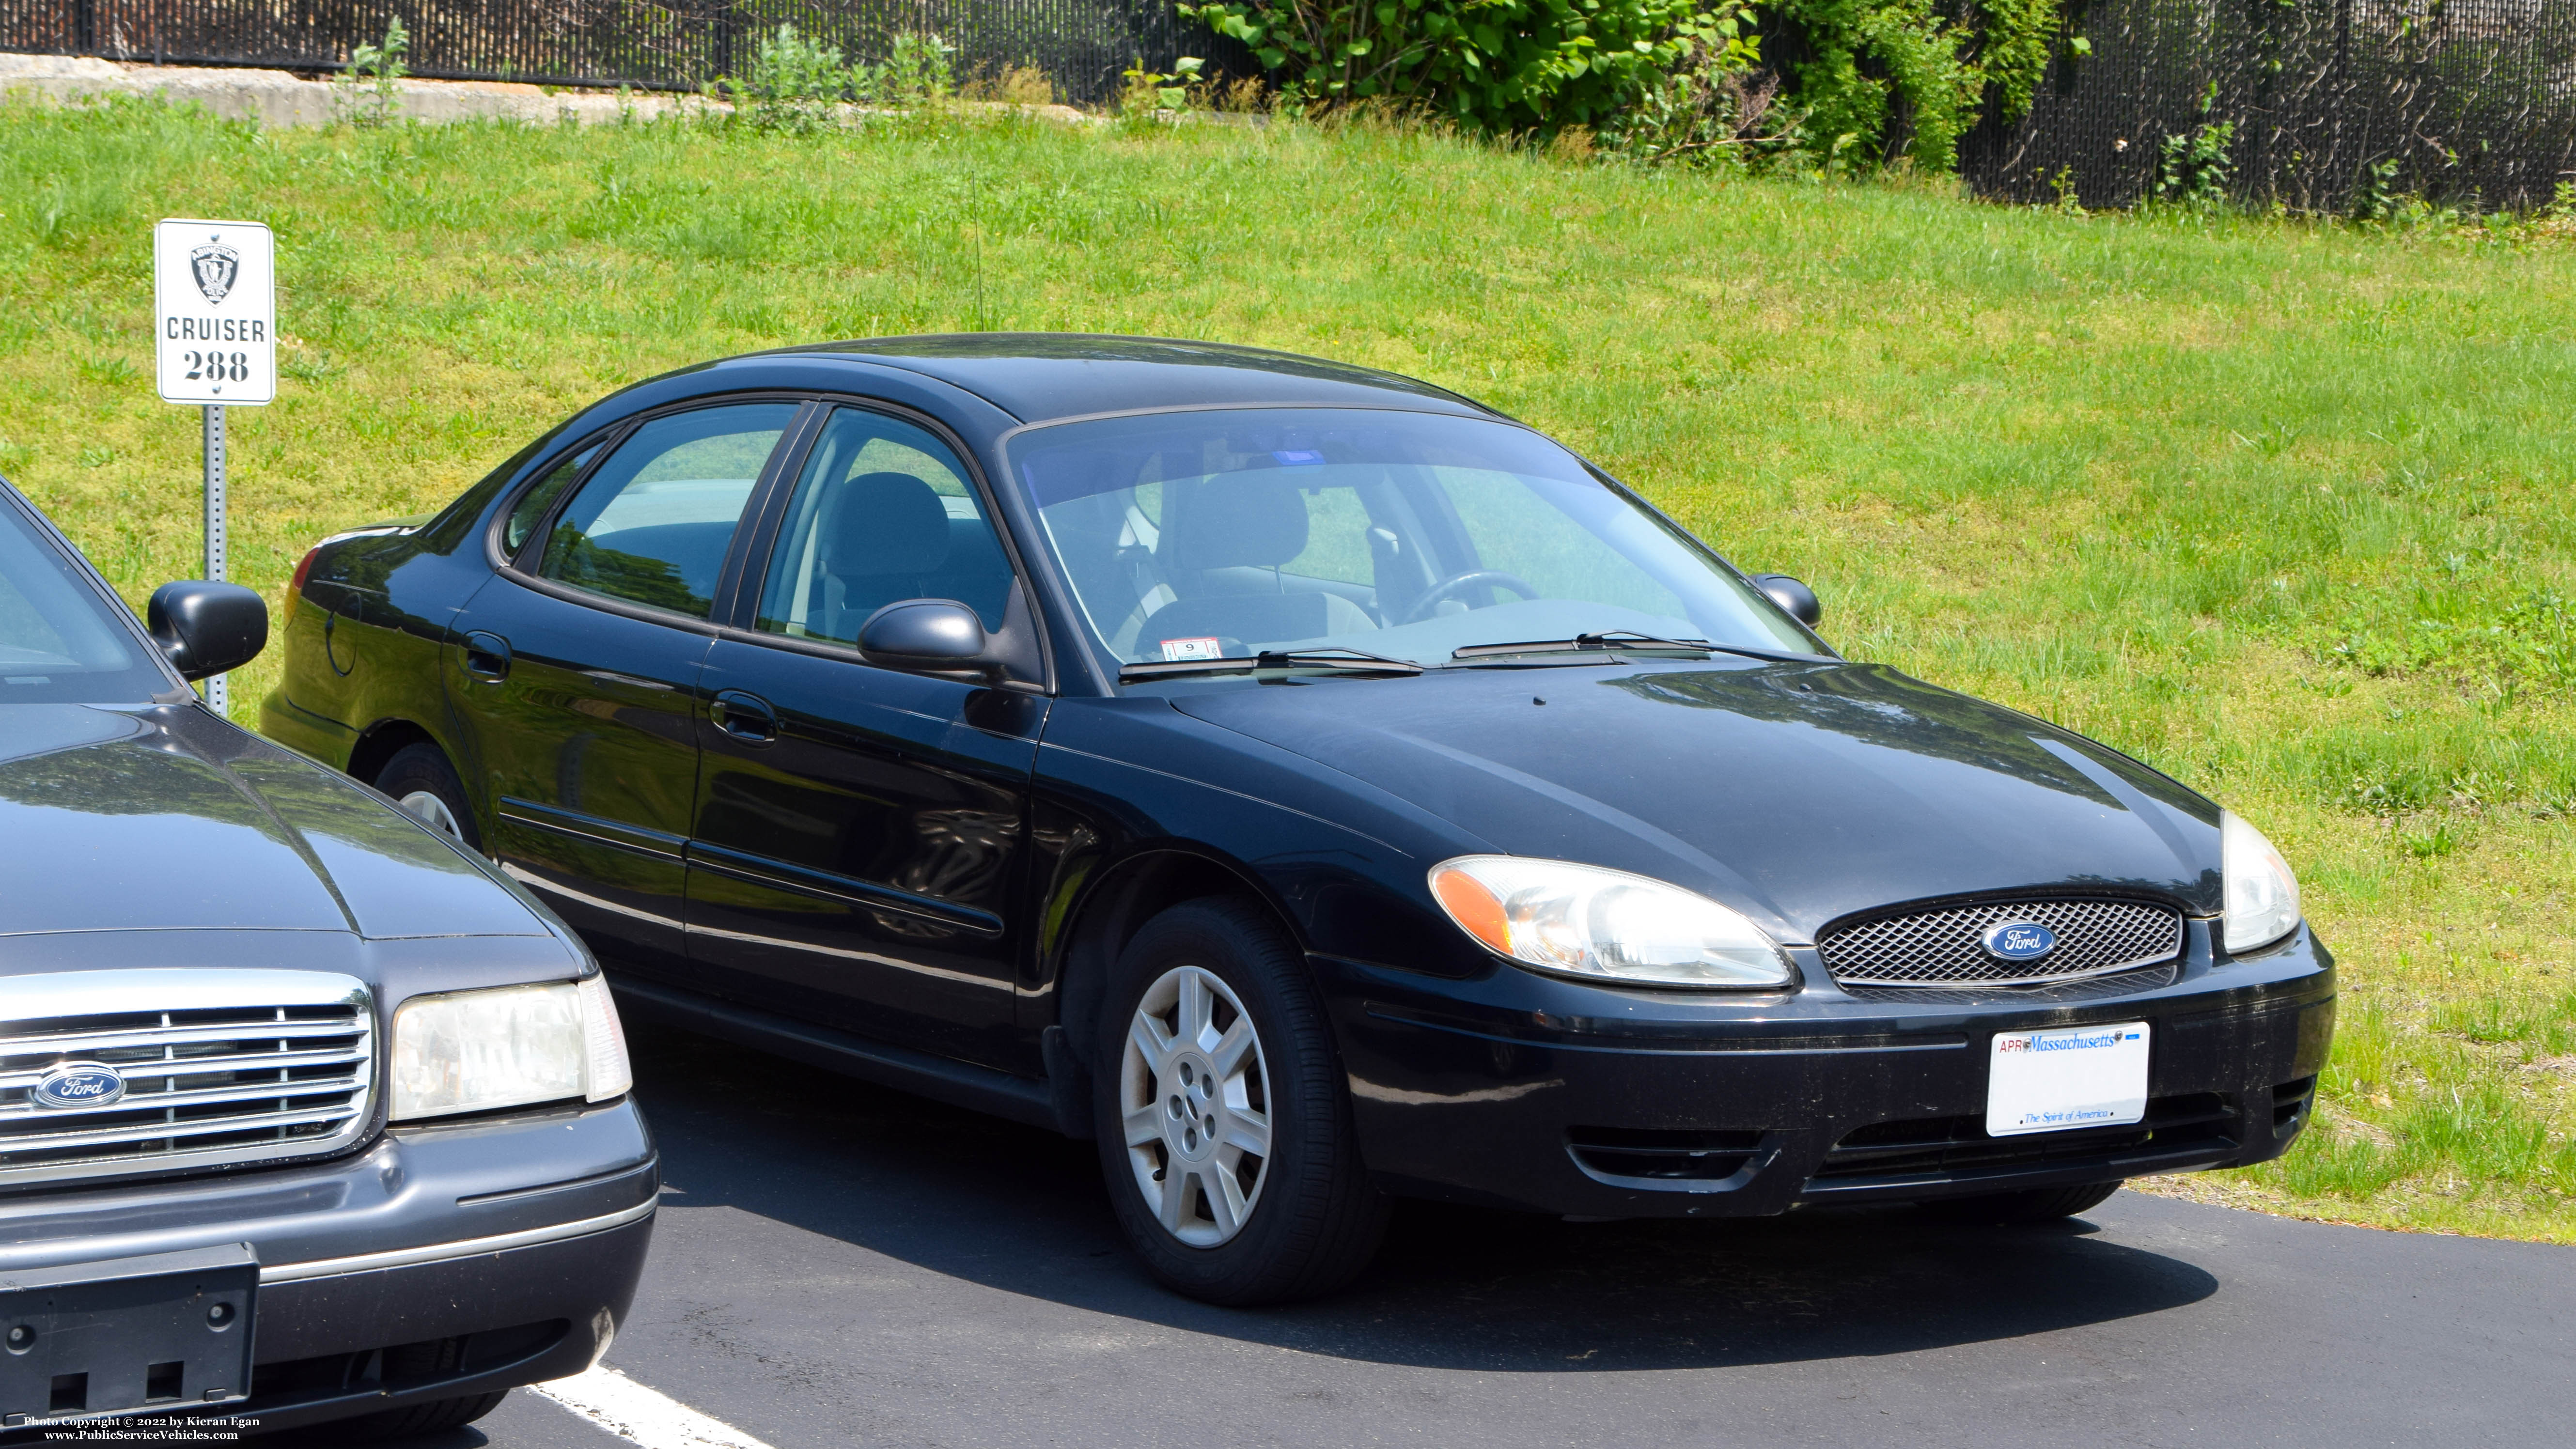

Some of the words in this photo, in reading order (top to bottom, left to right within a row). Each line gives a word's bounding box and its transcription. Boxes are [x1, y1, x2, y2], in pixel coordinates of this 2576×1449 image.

[191, 246, 238, 262] ABINGTON
[203, 285, 229, 296] POLICE
[167, 317, 264, 342] CRUISER
[184, 350, 249, 382] 288
[2005, 930, 2041, 950] Ford
[1999, 1040, 2022, 1053] APR
[2029, 1033, 2114, 1052] Massachusetts
[61, 1076, 104, 1096] Ford
[2026, 1113, 2040, 1123] The
[2042, 1112, 2063, 1123] Spirit
[2066, 1110, 2074, 1122] of
[2075, 1110, 2108, 1119] America
